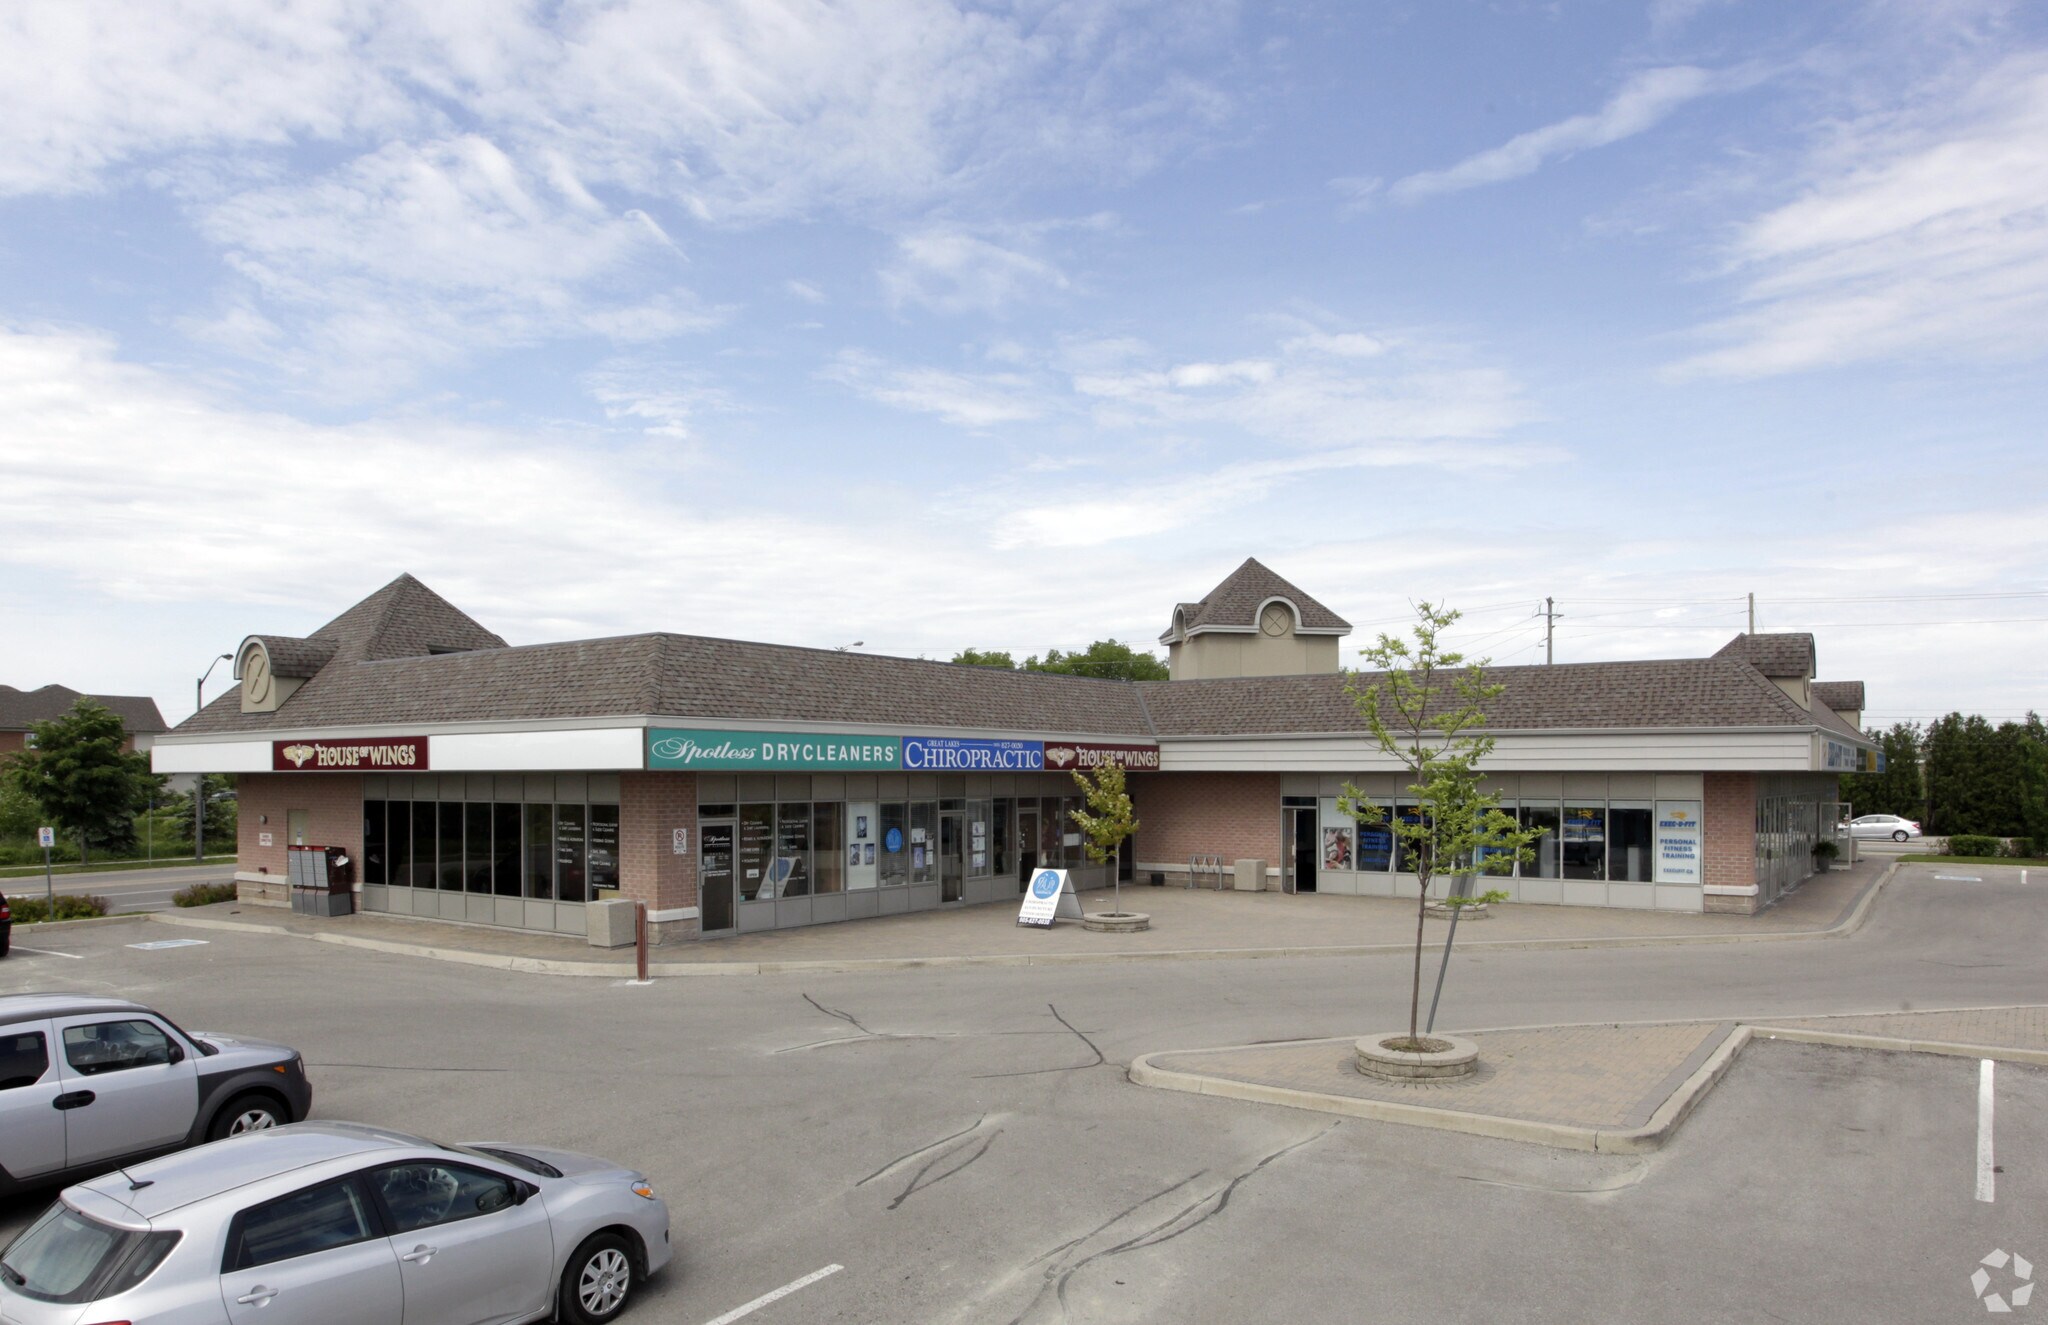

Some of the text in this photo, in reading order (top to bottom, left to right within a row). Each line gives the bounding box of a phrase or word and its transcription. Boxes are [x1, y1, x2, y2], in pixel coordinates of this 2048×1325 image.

[317, 744, 416, 766] HOUSE OF WINGS
[652, 737, 894, 763] Spotless DRYCLEANERS
[905, 741, 1041, 768] CHIROPRACTIC
[927, 740, 944, 748] GREAT
[1124, 751, 1159, 766] WINGS
